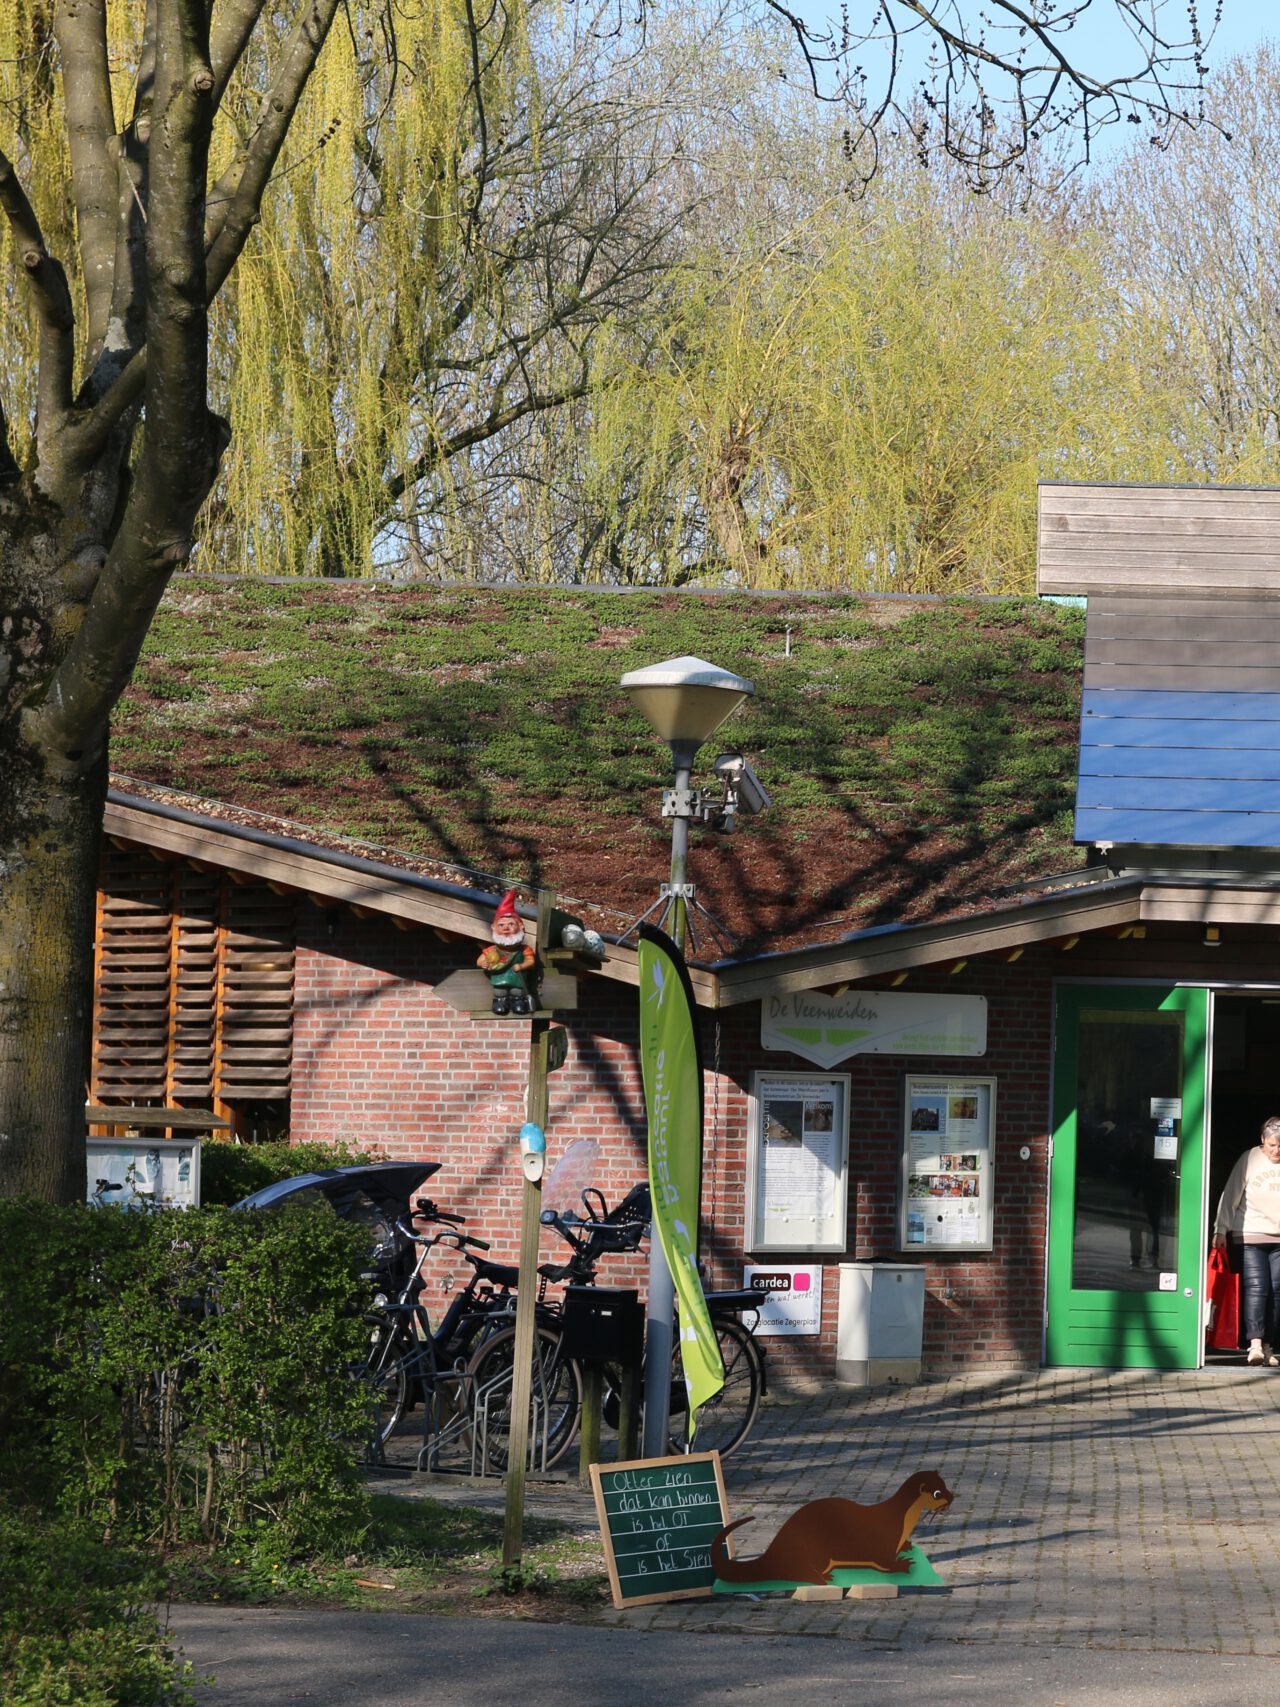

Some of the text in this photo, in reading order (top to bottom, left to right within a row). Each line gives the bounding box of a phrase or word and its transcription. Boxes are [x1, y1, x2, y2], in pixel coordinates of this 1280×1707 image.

[770, 997, 878, 1020] De Veenweiden
[753, 1276, 789, 1288] cardea
[746, 1318, 817, 1328] Zoglocatie Zegerplas
[613, 1472, 655, 1491] Otter
[619, 1490, 712, 1512] dat kan binnen
[631, 1517, 644, 1533] is
[637, 1560, 648, 1574] is
[658, 1554, 678, 1572] het
